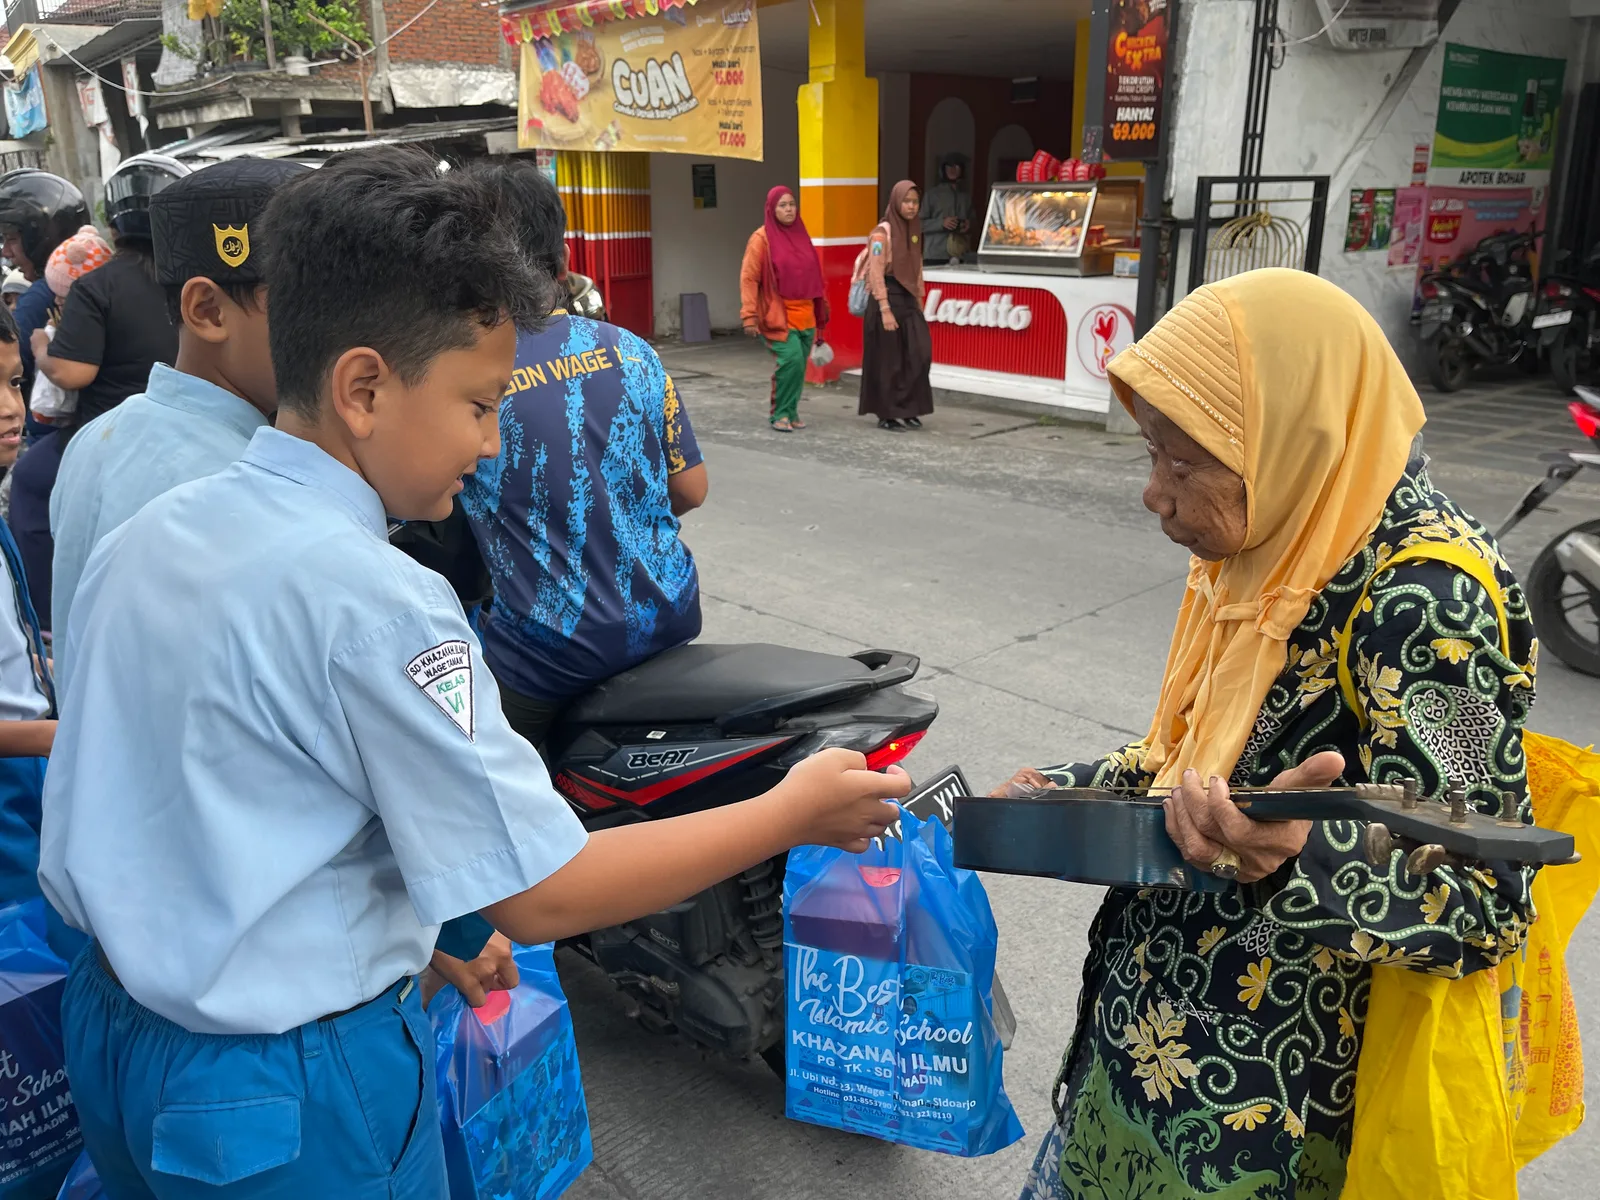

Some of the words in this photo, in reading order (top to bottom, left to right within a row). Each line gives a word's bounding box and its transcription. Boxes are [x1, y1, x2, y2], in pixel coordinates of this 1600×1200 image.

[611, 51, 692, 108] CUAN
[714, 70, 744, 85] 15.000
[1116, 107, 1153, 121] HANYA!
[1112, 123, 1156, 141] 69.000
[1459, 171, 1496, 185] APOTEK
[924, 289, 1032, 331] Lazatto
[547, 348, 613, 381] WAGE
[409, 663, 422, 677] SD
[424, 662, 448, 679] WAGE
[436, 674, 466, 694] KELAS
[783, 942, 832, 1002] The
[832, 955, 904, 1018] Best
[799, 999, 889, 1035] Islamic
[894, 1013, 973, 1046] School
[817, 1055, 836, 1068] PG
[844, 1063, 863, 1075] TK
[874, 1067, 893, 1079] SD
[901, 1074, 943, 1088] MADIN
[912, 1053, 968, 1074] ILMU
[802, 1071, 819, 1082] Ubi
[856, 1084, 885, 1097] Wage
[813, 1087, 840, 1098] Hotline
[32, 1111, 69, 1137] MADIN
